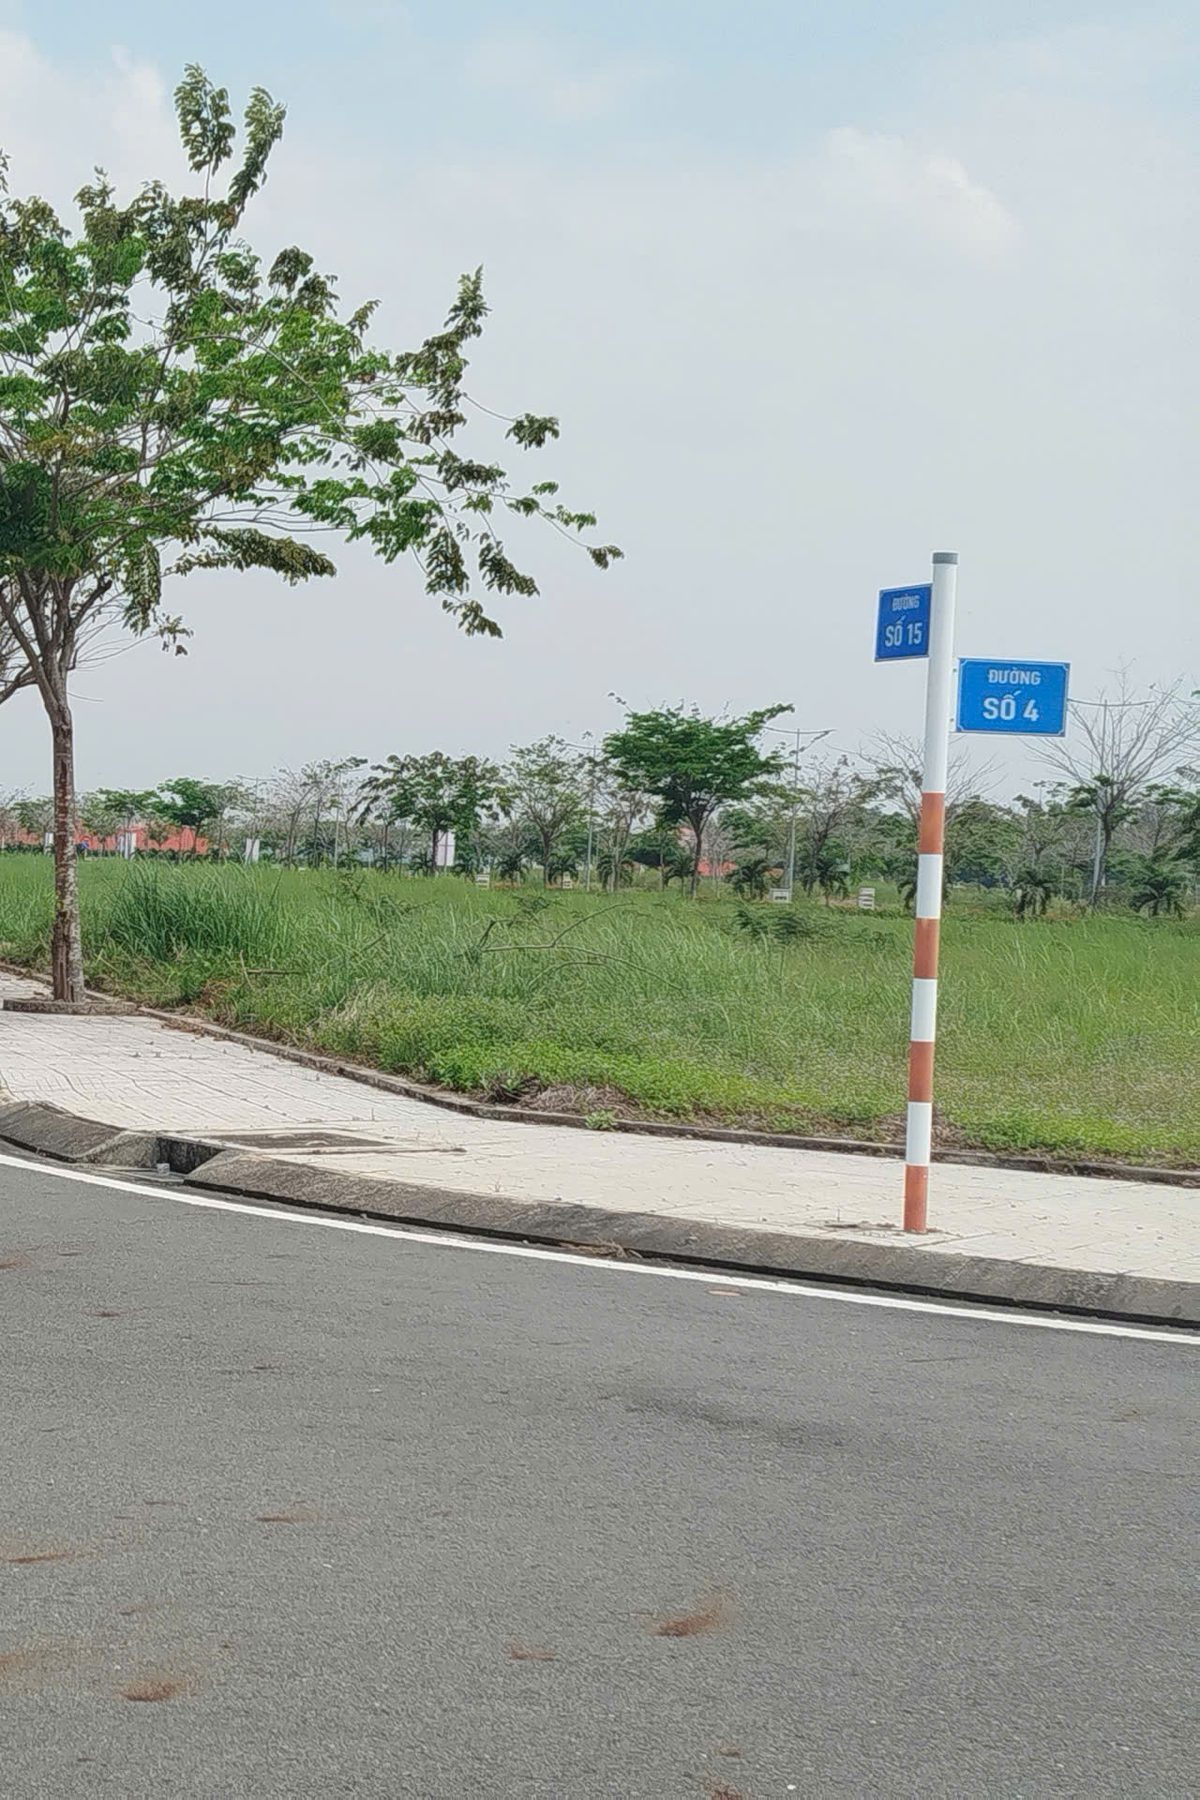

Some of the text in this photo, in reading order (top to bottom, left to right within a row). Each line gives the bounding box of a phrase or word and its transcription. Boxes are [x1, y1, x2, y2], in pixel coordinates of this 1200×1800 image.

[885, 616, 922, 646] SỐ 15
[988, 667, 1041, 685] ĐƯỜNG
[983, 690, 1039, 721] SỐ 4
